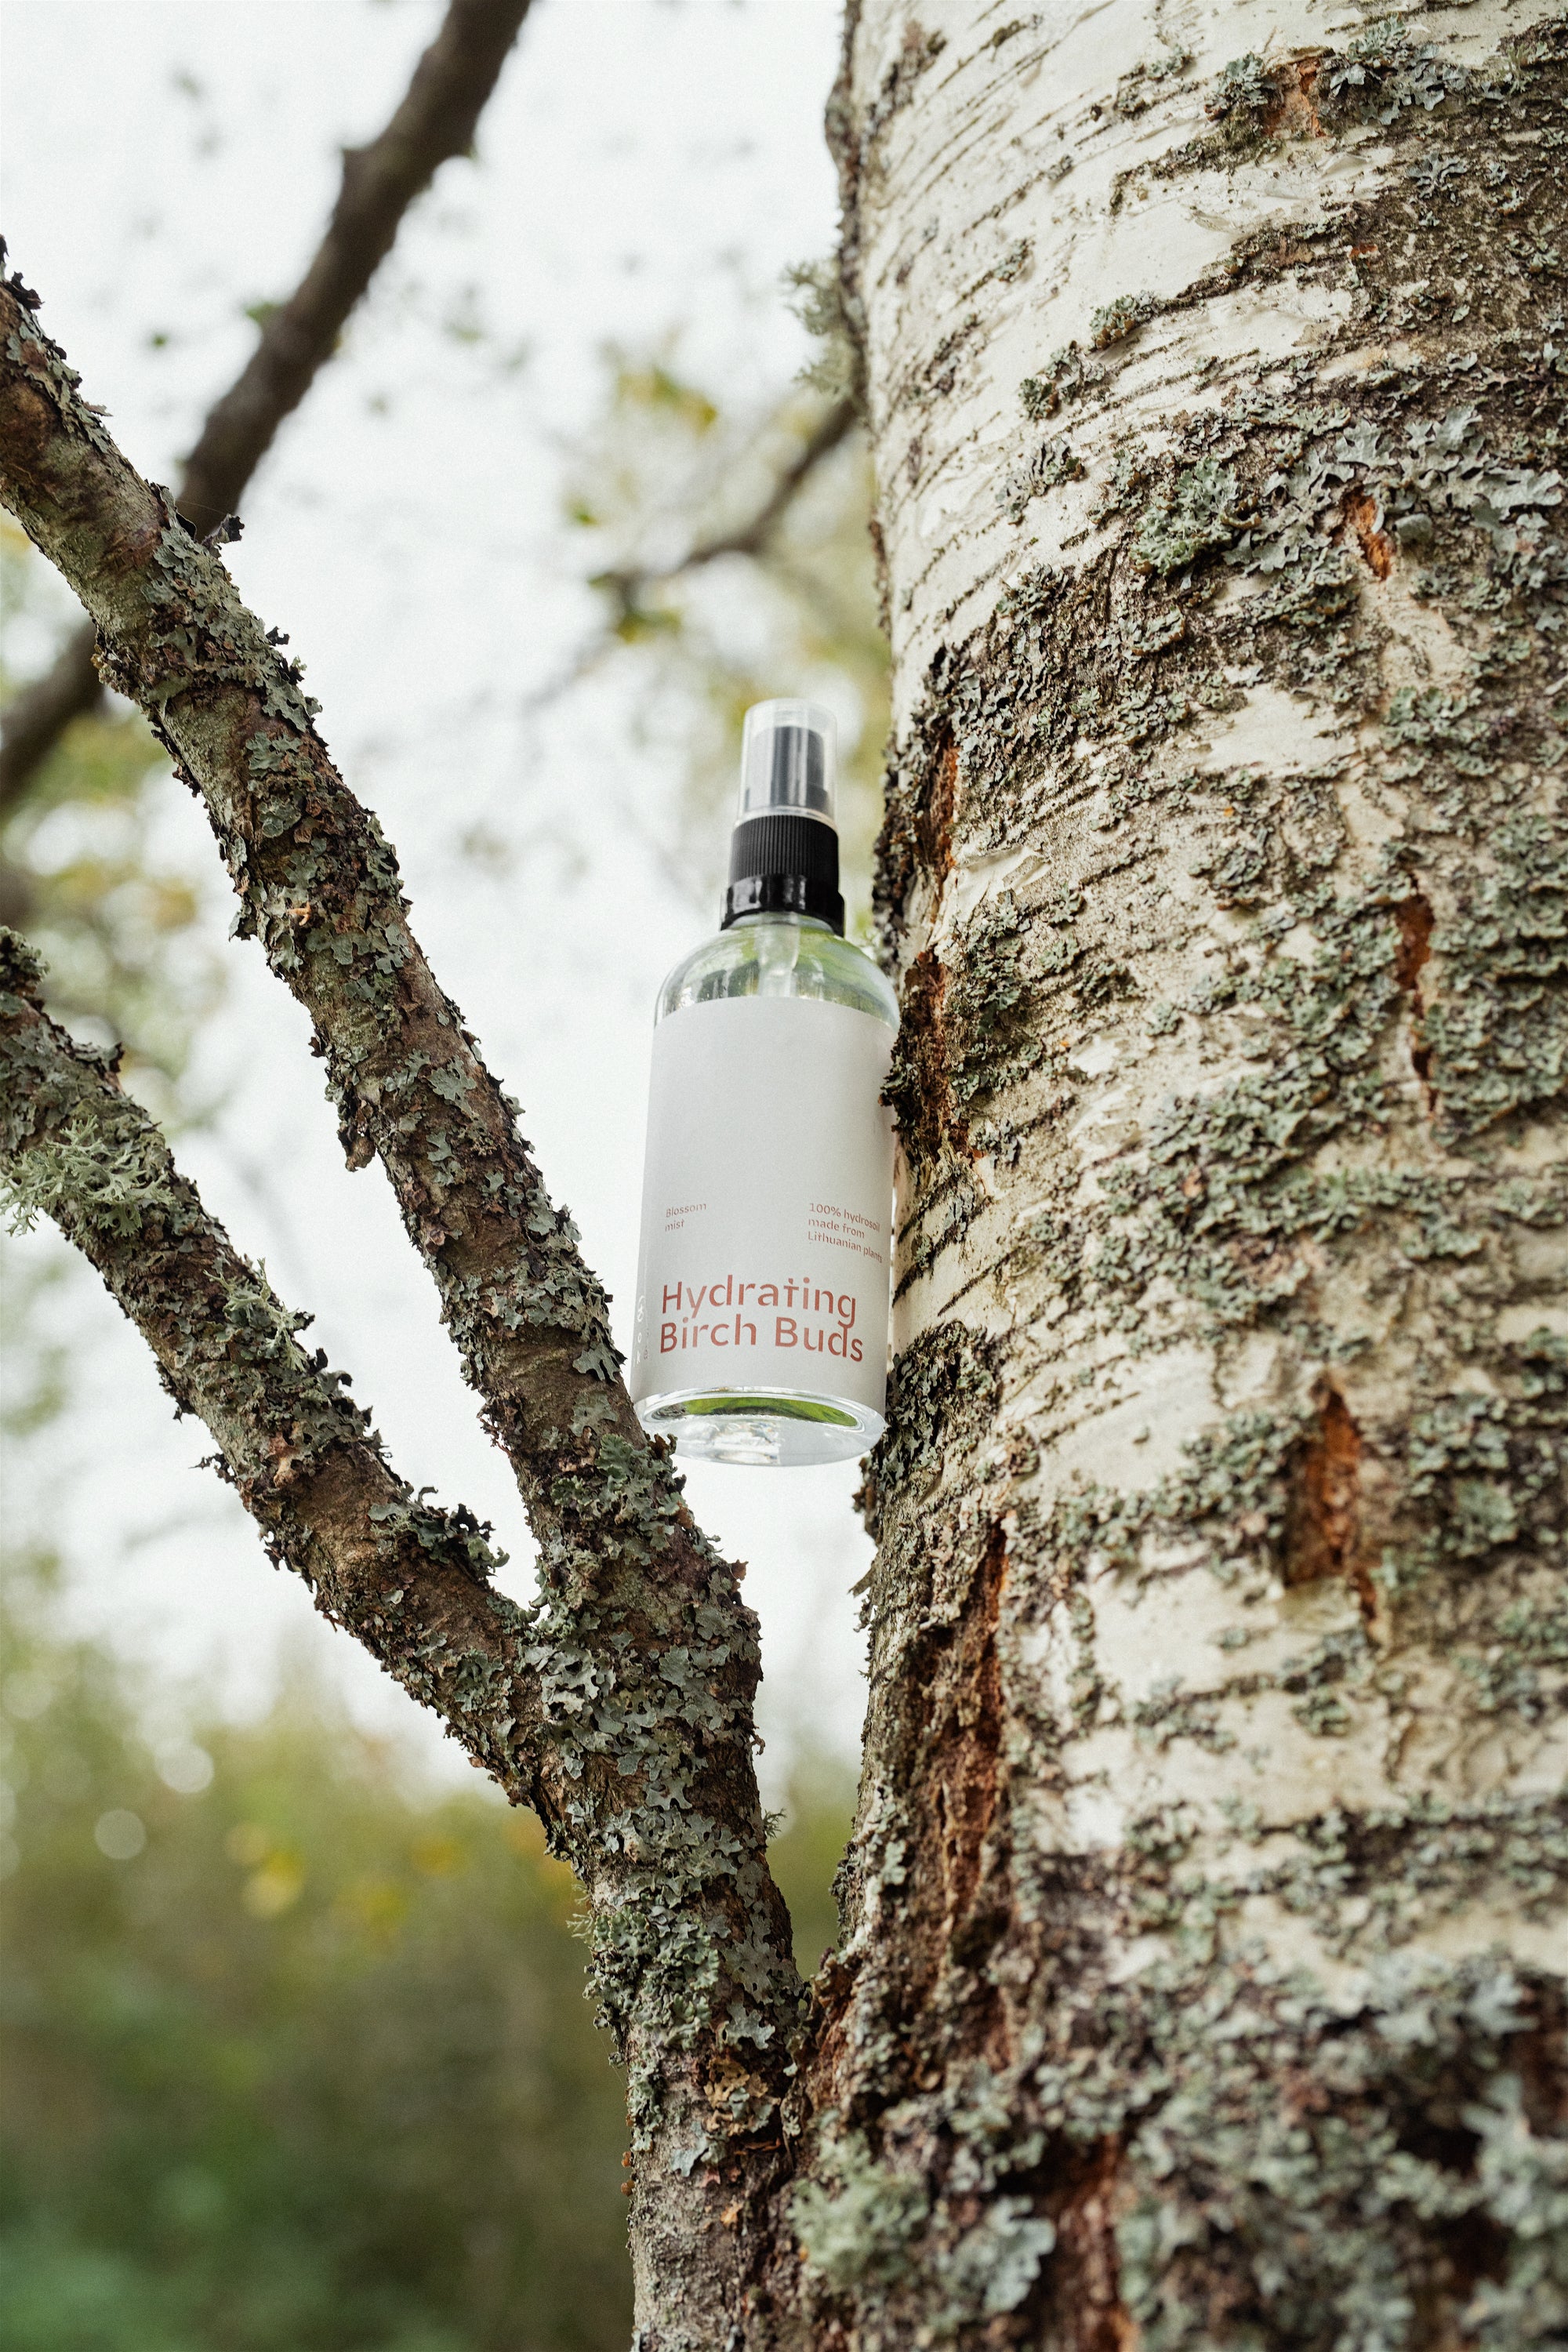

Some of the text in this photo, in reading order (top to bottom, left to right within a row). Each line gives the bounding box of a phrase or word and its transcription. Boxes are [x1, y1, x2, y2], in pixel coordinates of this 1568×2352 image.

[666, 1203, 707, 1218] Blossom
[809, 1203, 841, 1218] 100%
[665, 1218, 684, 1232] mist
[808, 1219, 865, 1239] made from
[808, 1231, 883, 1263] Lithuanian plants
[662, 1275, 856, 1329] Hydrating
[660, 1313, 757, 1353] Birch
[775, 1317, 863, 1362] Buds
